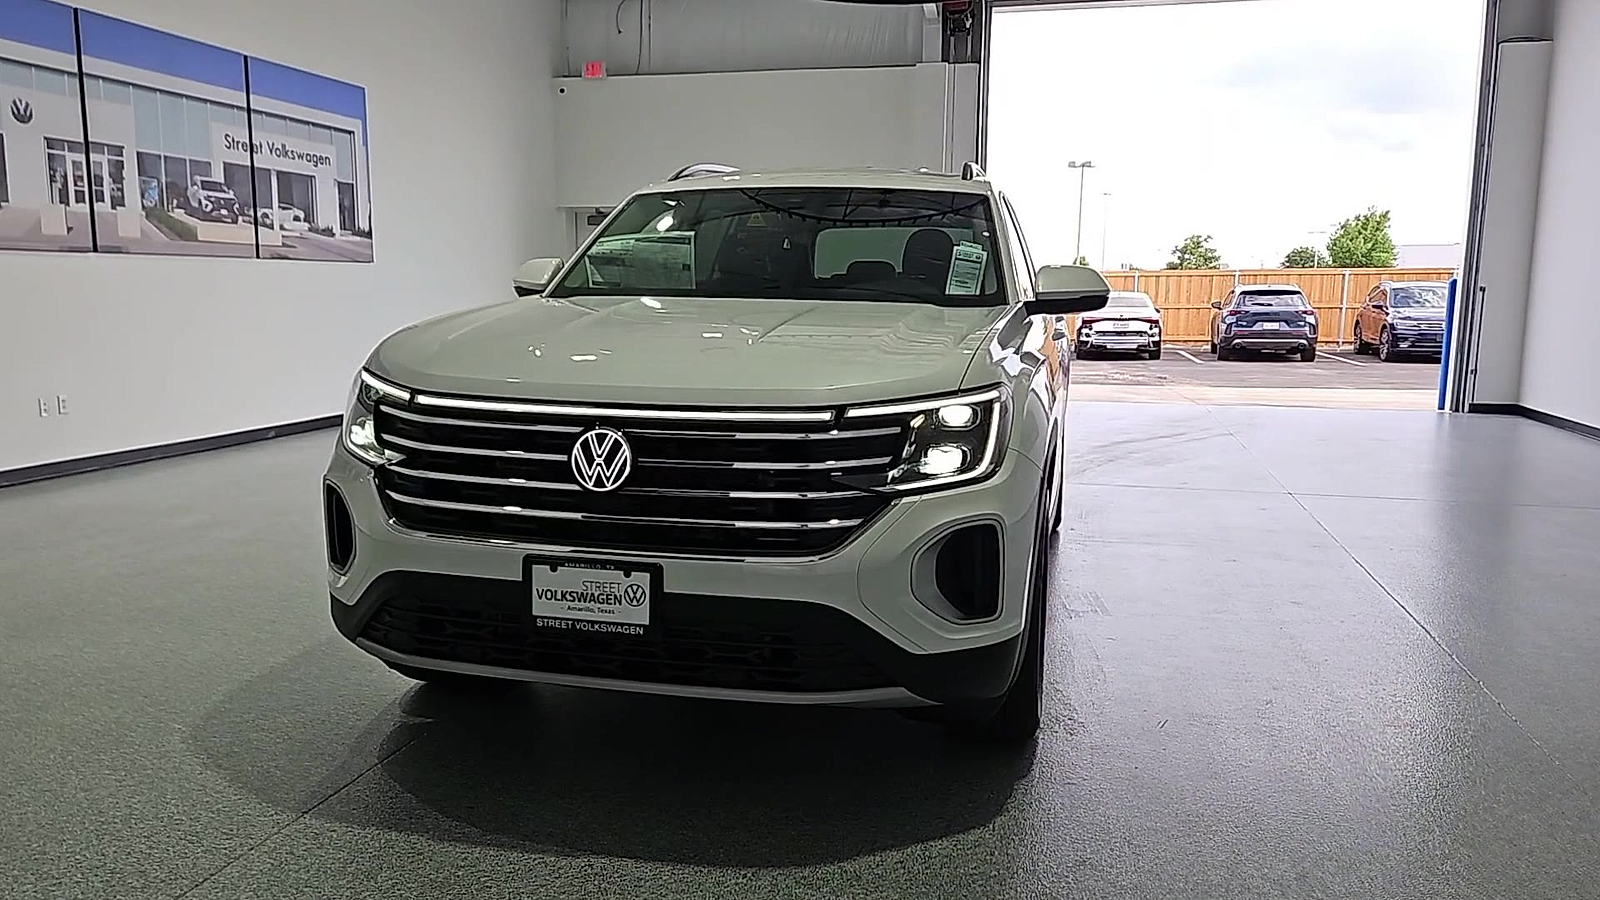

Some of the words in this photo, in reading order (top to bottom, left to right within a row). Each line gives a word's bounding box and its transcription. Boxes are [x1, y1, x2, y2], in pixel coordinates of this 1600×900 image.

[223, 133, 263, 155] Street
[266, 140, 332, 168] Volkswagen
[582, 580, 622, 593] STREET
[536, 588, 622, 606] VOLKSWAGEN
[597, 607, 615, 615] Texas
[536, 618, 573, 629] STREET
[575, 621, 644, 635] VOLKSWAGEN
